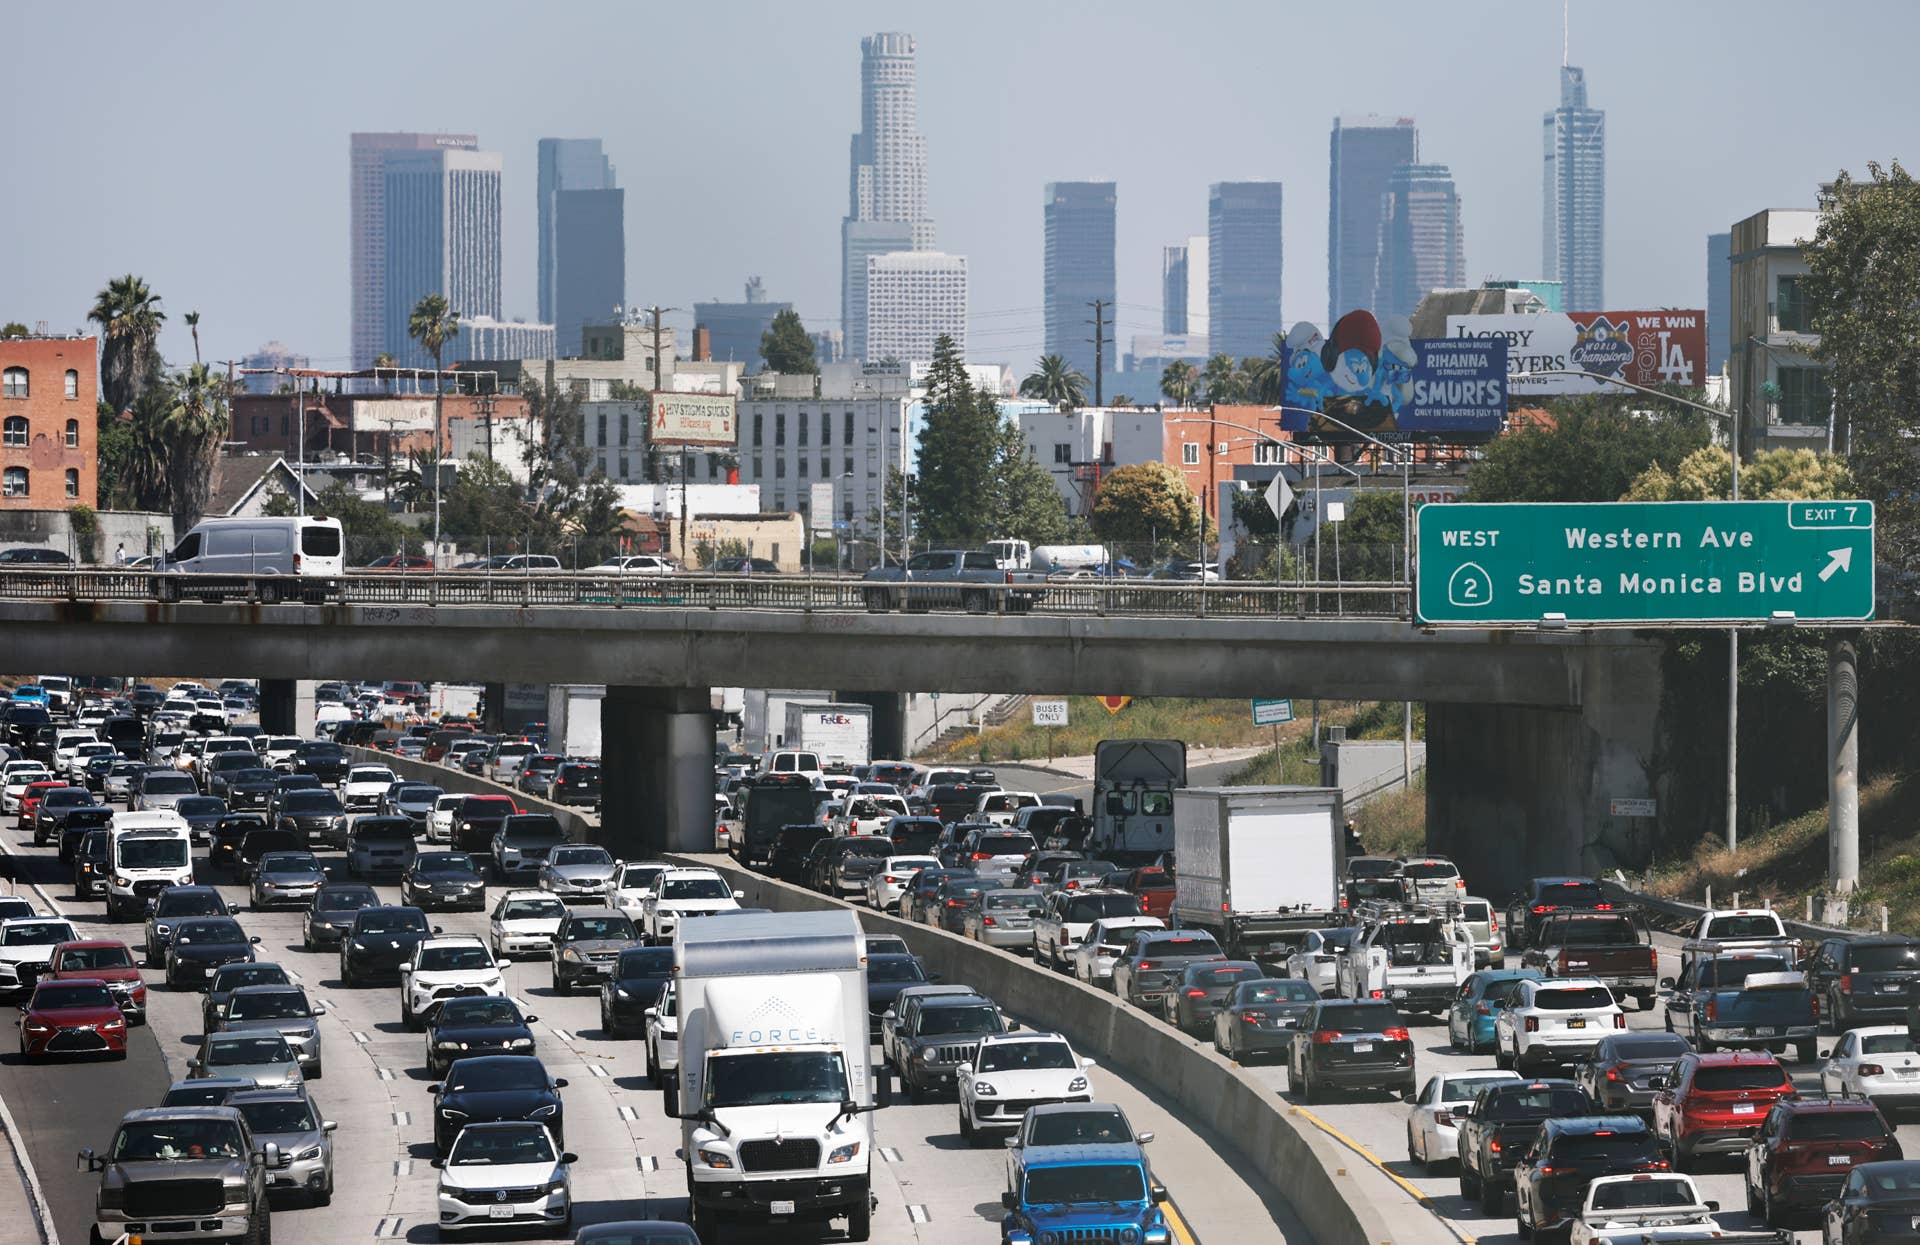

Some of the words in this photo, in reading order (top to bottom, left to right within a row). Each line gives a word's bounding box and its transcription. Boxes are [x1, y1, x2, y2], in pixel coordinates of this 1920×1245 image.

[1637, 317, 1660, 328] WE
[1664, 317, 1696, 328] WIN
[1586, 342, 1617, 351] WORLD
[1427, 354, 1489, 368] RIHANNA
[1507, 355, 1566, 372] EYERS
[1572, 348, 1632, 364] Champions
[1658, 331, 1694, 386] LA
[1415, 380, 1501, 406] SMURFS
[680, 404, 705, 417] STIGMA
[1476, 409, 1492, 418] JULY
[1805, 509, 1837, 521] EXIT
[1844, 507, 1857, 522] 7
[1442, 531, 1500, 547] WEST
[1565, 527, 1681, 549] Western
[1700, 526, 1753, 548] Ave
[1464, 578, 1478, 599] 2
[1518, 574, 1602, 595] Santa
[1620, 573, 1721, 595] Monica
[1738, 572, 1802, 593] Blvd
[1036, 705, 1064, 713] BUSES
[821, 715, 850, 725] FedEx
[1039, 713, 1061, 721] ONLY
[732, 1028, 817, 1043] FORCE
